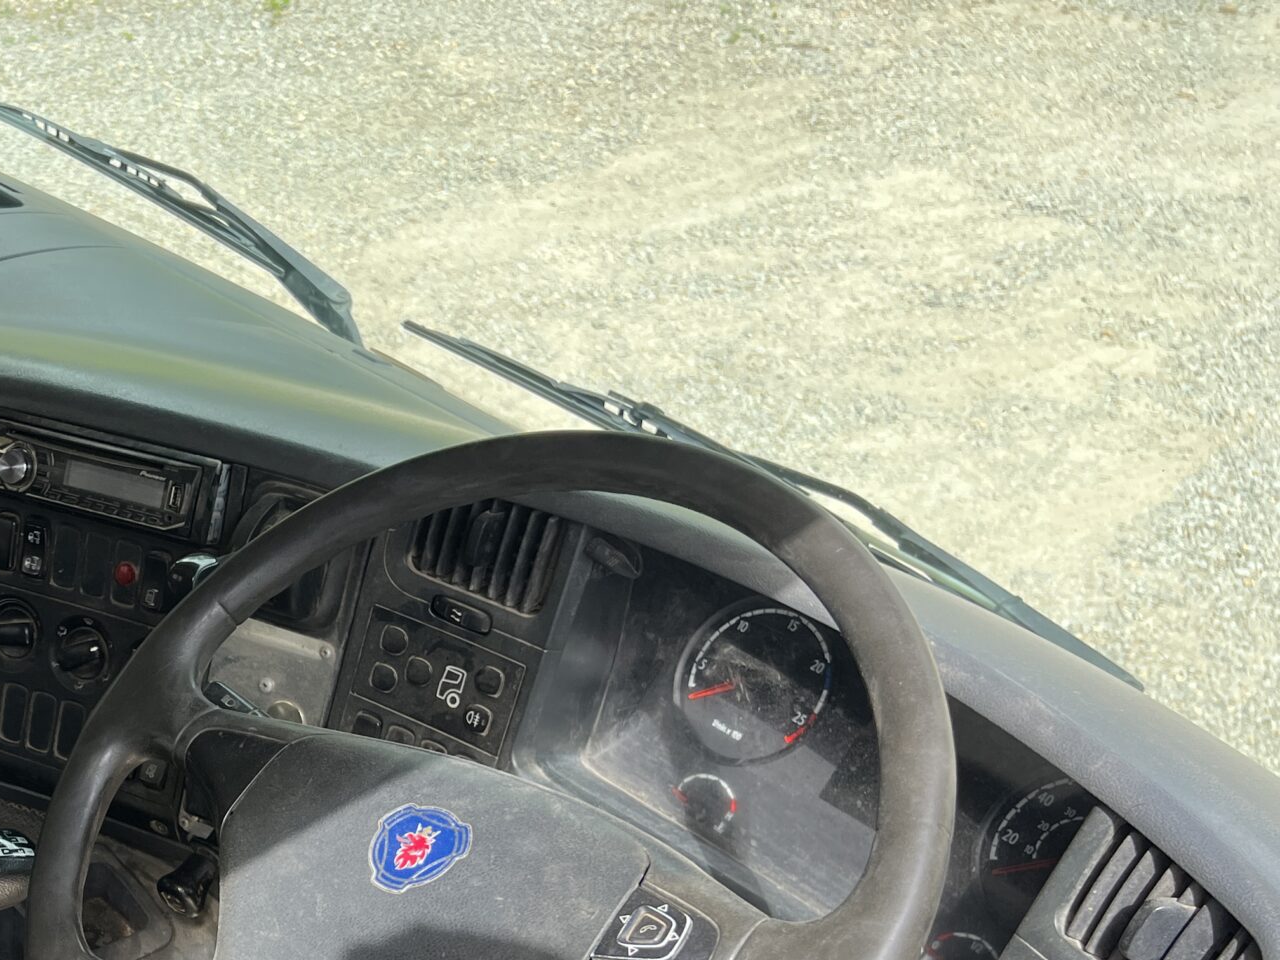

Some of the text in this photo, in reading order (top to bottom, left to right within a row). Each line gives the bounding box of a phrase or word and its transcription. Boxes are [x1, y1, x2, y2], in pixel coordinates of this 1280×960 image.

[736, 620, 750, 633] 10
[787, 619, 800, 632] 15
[698, 659, 708, 671] 5
[809, 659, 826, 674] 20
[791, 711, 808, 726] 25
[1038, 791, 1054, 807] 40
[1063, 806, 1077, 818] 30
[1037, 820, 1050, 832] 20
[1001, 828, 1020, 845] 20
[1023, 844, 1035, 855] 10
